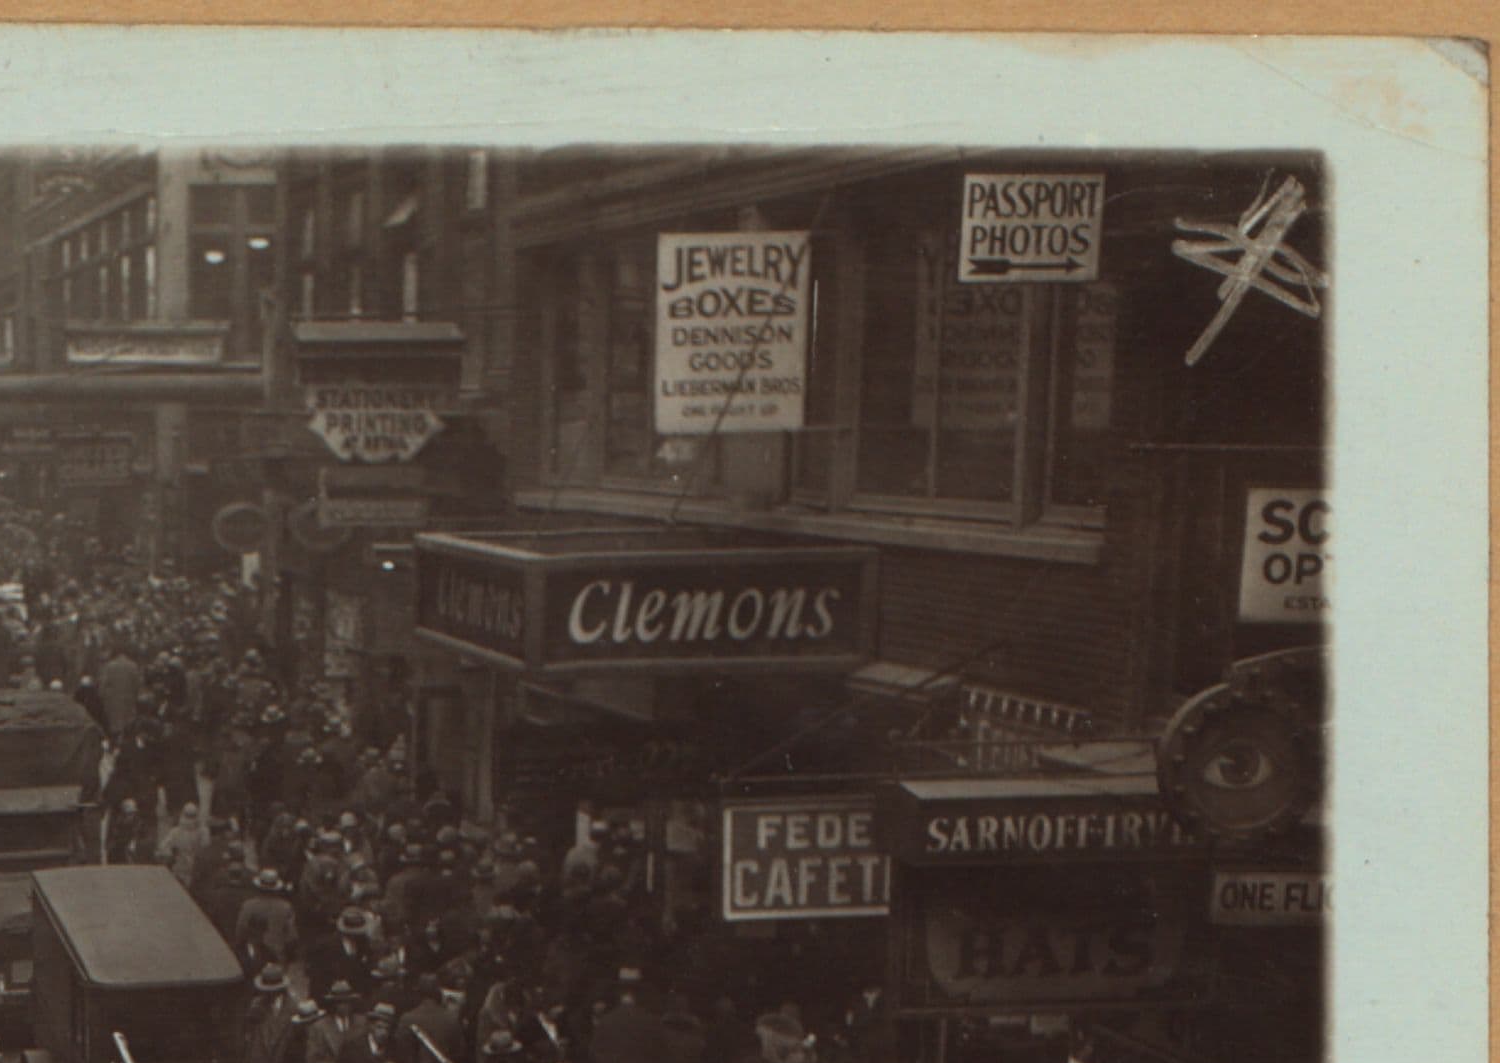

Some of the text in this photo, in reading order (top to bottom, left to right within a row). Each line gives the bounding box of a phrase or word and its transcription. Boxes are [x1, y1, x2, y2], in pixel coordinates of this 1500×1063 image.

[969, 182, 1100, 218] PASSPORT
[971, 225, 1090, 256] PHOTOS
[661, 244, 804, 292] JEWELRY
[668, 286, 796, 320] BOXES
[672, 325, 794, 347] DENNISON
[689, 351, 774, 372] GOODS
[327, 412, 428, 435] PRINTING
[567, 580, 842, 645] Clemons
[1219, 882, 1276, 912] ONE
